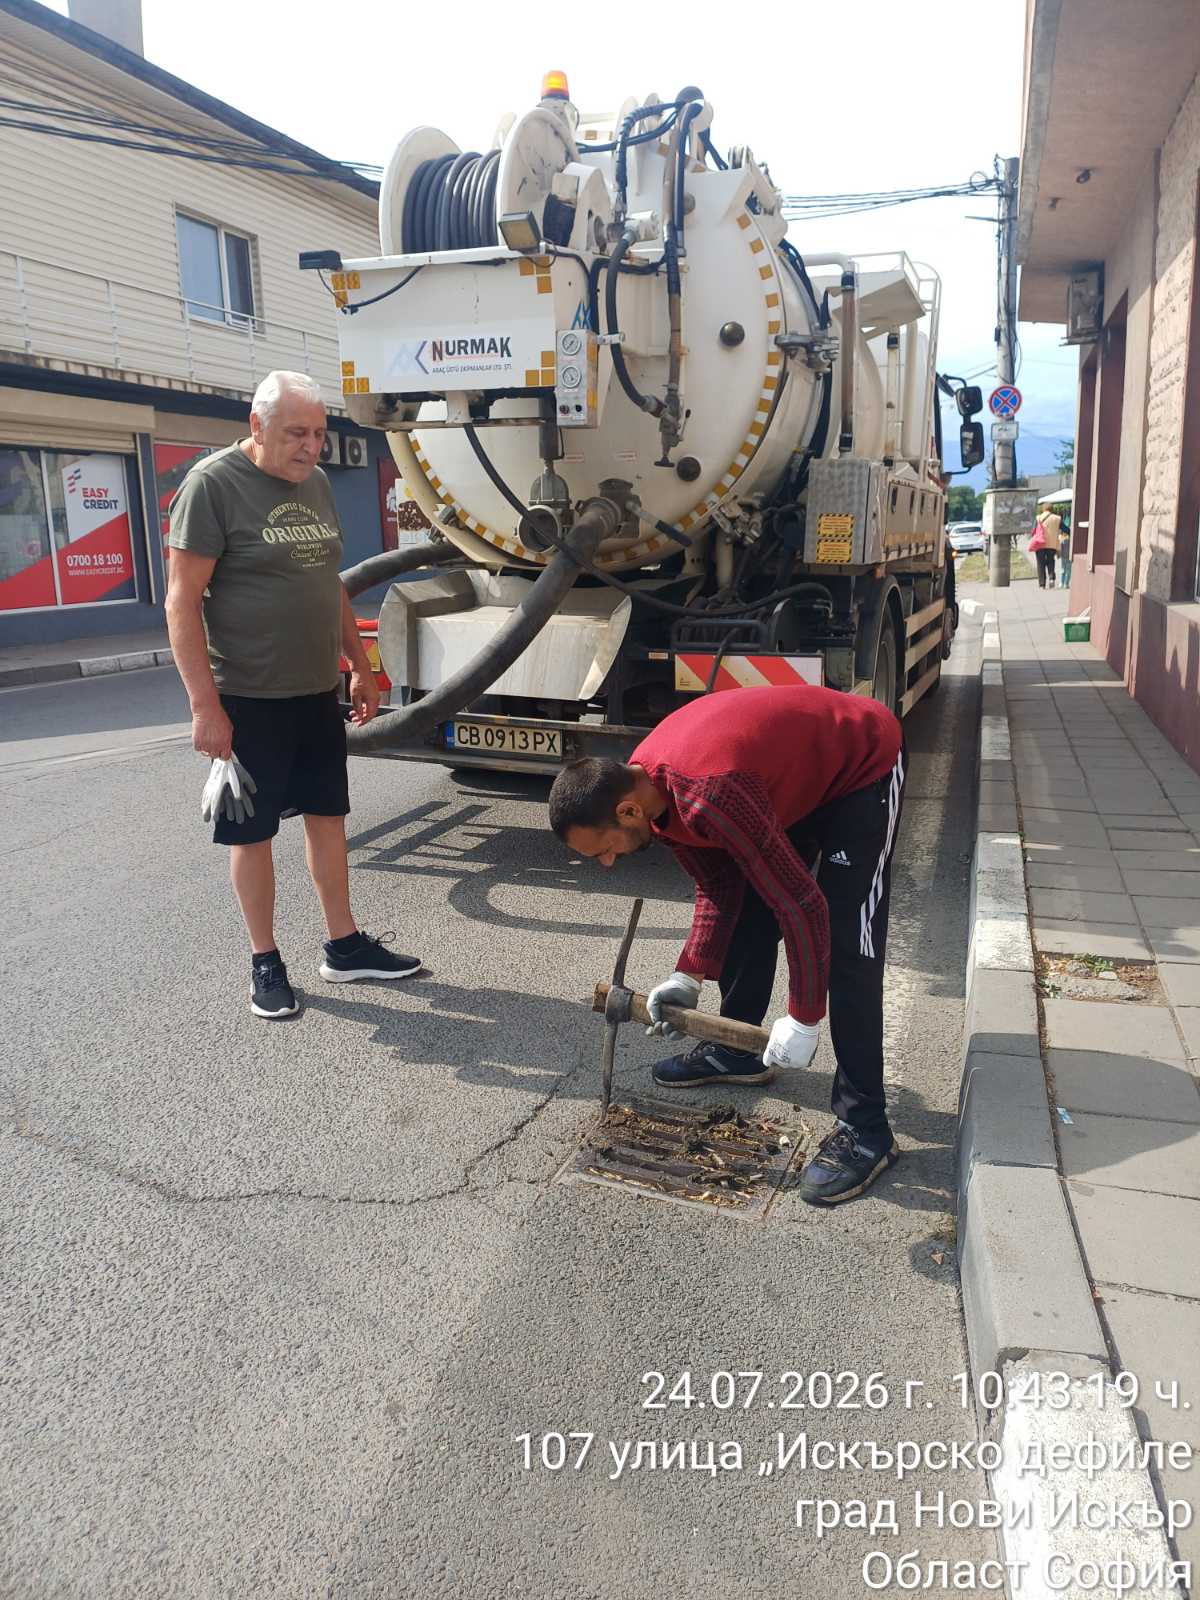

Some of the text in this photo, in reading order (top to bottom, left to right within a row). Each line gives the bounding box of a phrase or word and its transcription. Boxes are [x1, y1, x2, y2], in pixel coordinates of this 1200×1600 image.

[432, 336, 512, 361] NURMAK
[82, 487, 109, 498] EASY
[262, 523, 339, 544] ORIGINAL
[67, 553, 123, 566] 0700 18 100
[457, 725, 559, 754] CB 0913 PX
